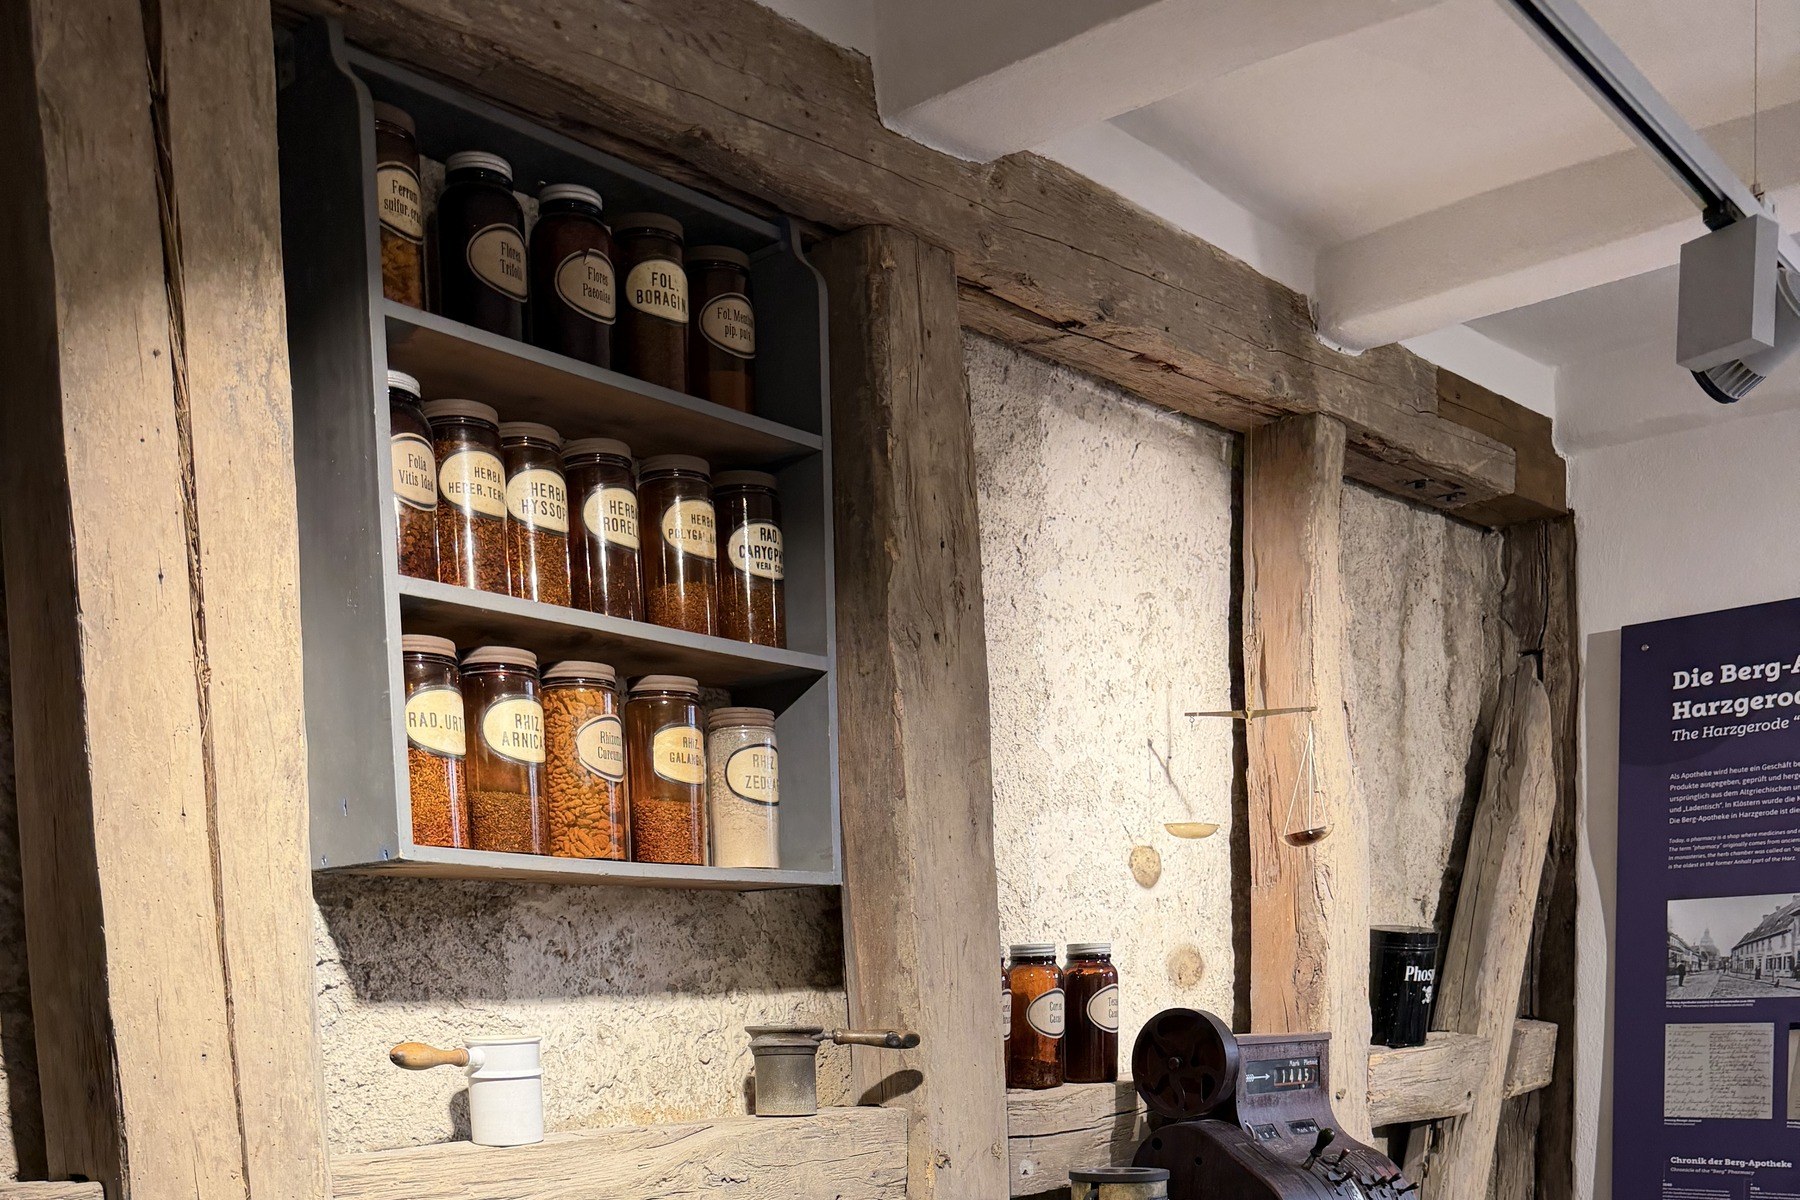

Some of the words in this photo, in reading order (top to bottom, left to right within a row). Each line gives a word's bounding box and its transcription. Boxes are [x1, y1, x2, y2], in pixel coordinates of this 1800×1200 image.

[588, 266, 609, 286] Flores
[652, 272, 679, 292] FOL.
[408, 453, 427, 471] Folia
[398, 469, 419, 487] Vitis
[1673, 667, 1714, 690] Die
[1672, 728, 1699, 741] The
[1702, 717, 1790, 738] Harzgerode
[1681, 770, 1712, 780] Apotheke
[1713, 768, 1728, 776] wird
[1762, 761, 1792, 771] Geschäft
[1670, 782, 1699, 791] Produkte
[1700, 778, 1741, 789] ausgegeben,
[1742, 775, 1767, 786] geprüft
[1768, 774, 1782, 782] und
[1669, 792, 1710, 803] ursprünglich
[1711, 791, 1722, 799] aus
[1723, 789, 1738, 797] dem
[1739, 784, 1792, 797] Altgriechischen
[1669, 805, 1682, 813] und
[1733, 798, 1760, 807] Klöstern
[1761, 797, 1783, 805] wurde
[1784, 795, 1795, 803] die
[1669, 817, 1681, 825] Die
[1681, 813, 1730, 824] Berg-Apotheke
[1731, 811, 1738, 819] in
[1739, 808, 1779, 818] Harzgerode
[1780, 807, 1788, 815] ist
[1670, 1156, 1707, 1166] Chronik
[1708, 1157, 1723, 1165] der
[1724, 1158, 1793, 1169] Berg-Apotheke
